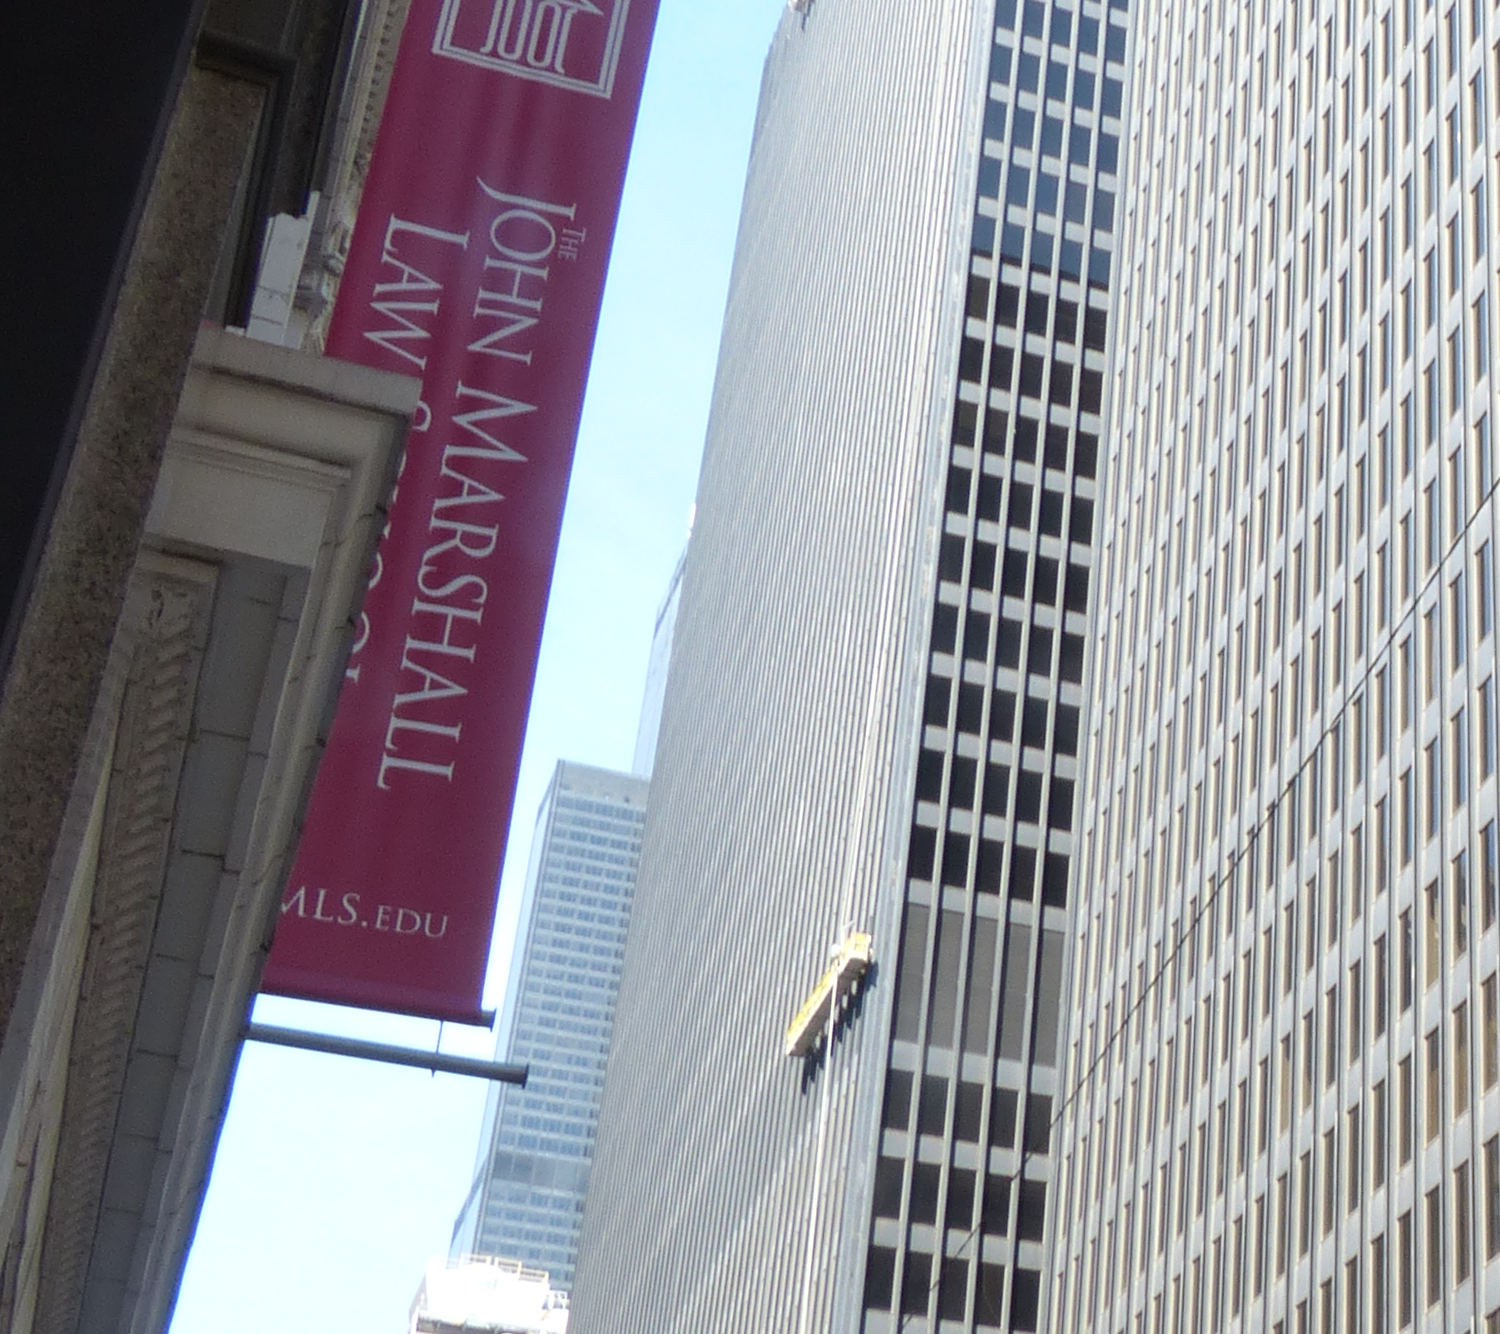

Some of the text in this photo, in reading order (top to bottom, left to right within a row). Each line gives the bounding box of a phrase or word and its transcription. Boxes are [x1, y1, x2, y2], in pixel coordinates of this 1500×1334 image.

[362, 214, 470, 369] LAW
[467, 175, 577, 366] JOHN
[555, 226, 587, 262] THE
[377, 379, 538, 791] MARSHALL
